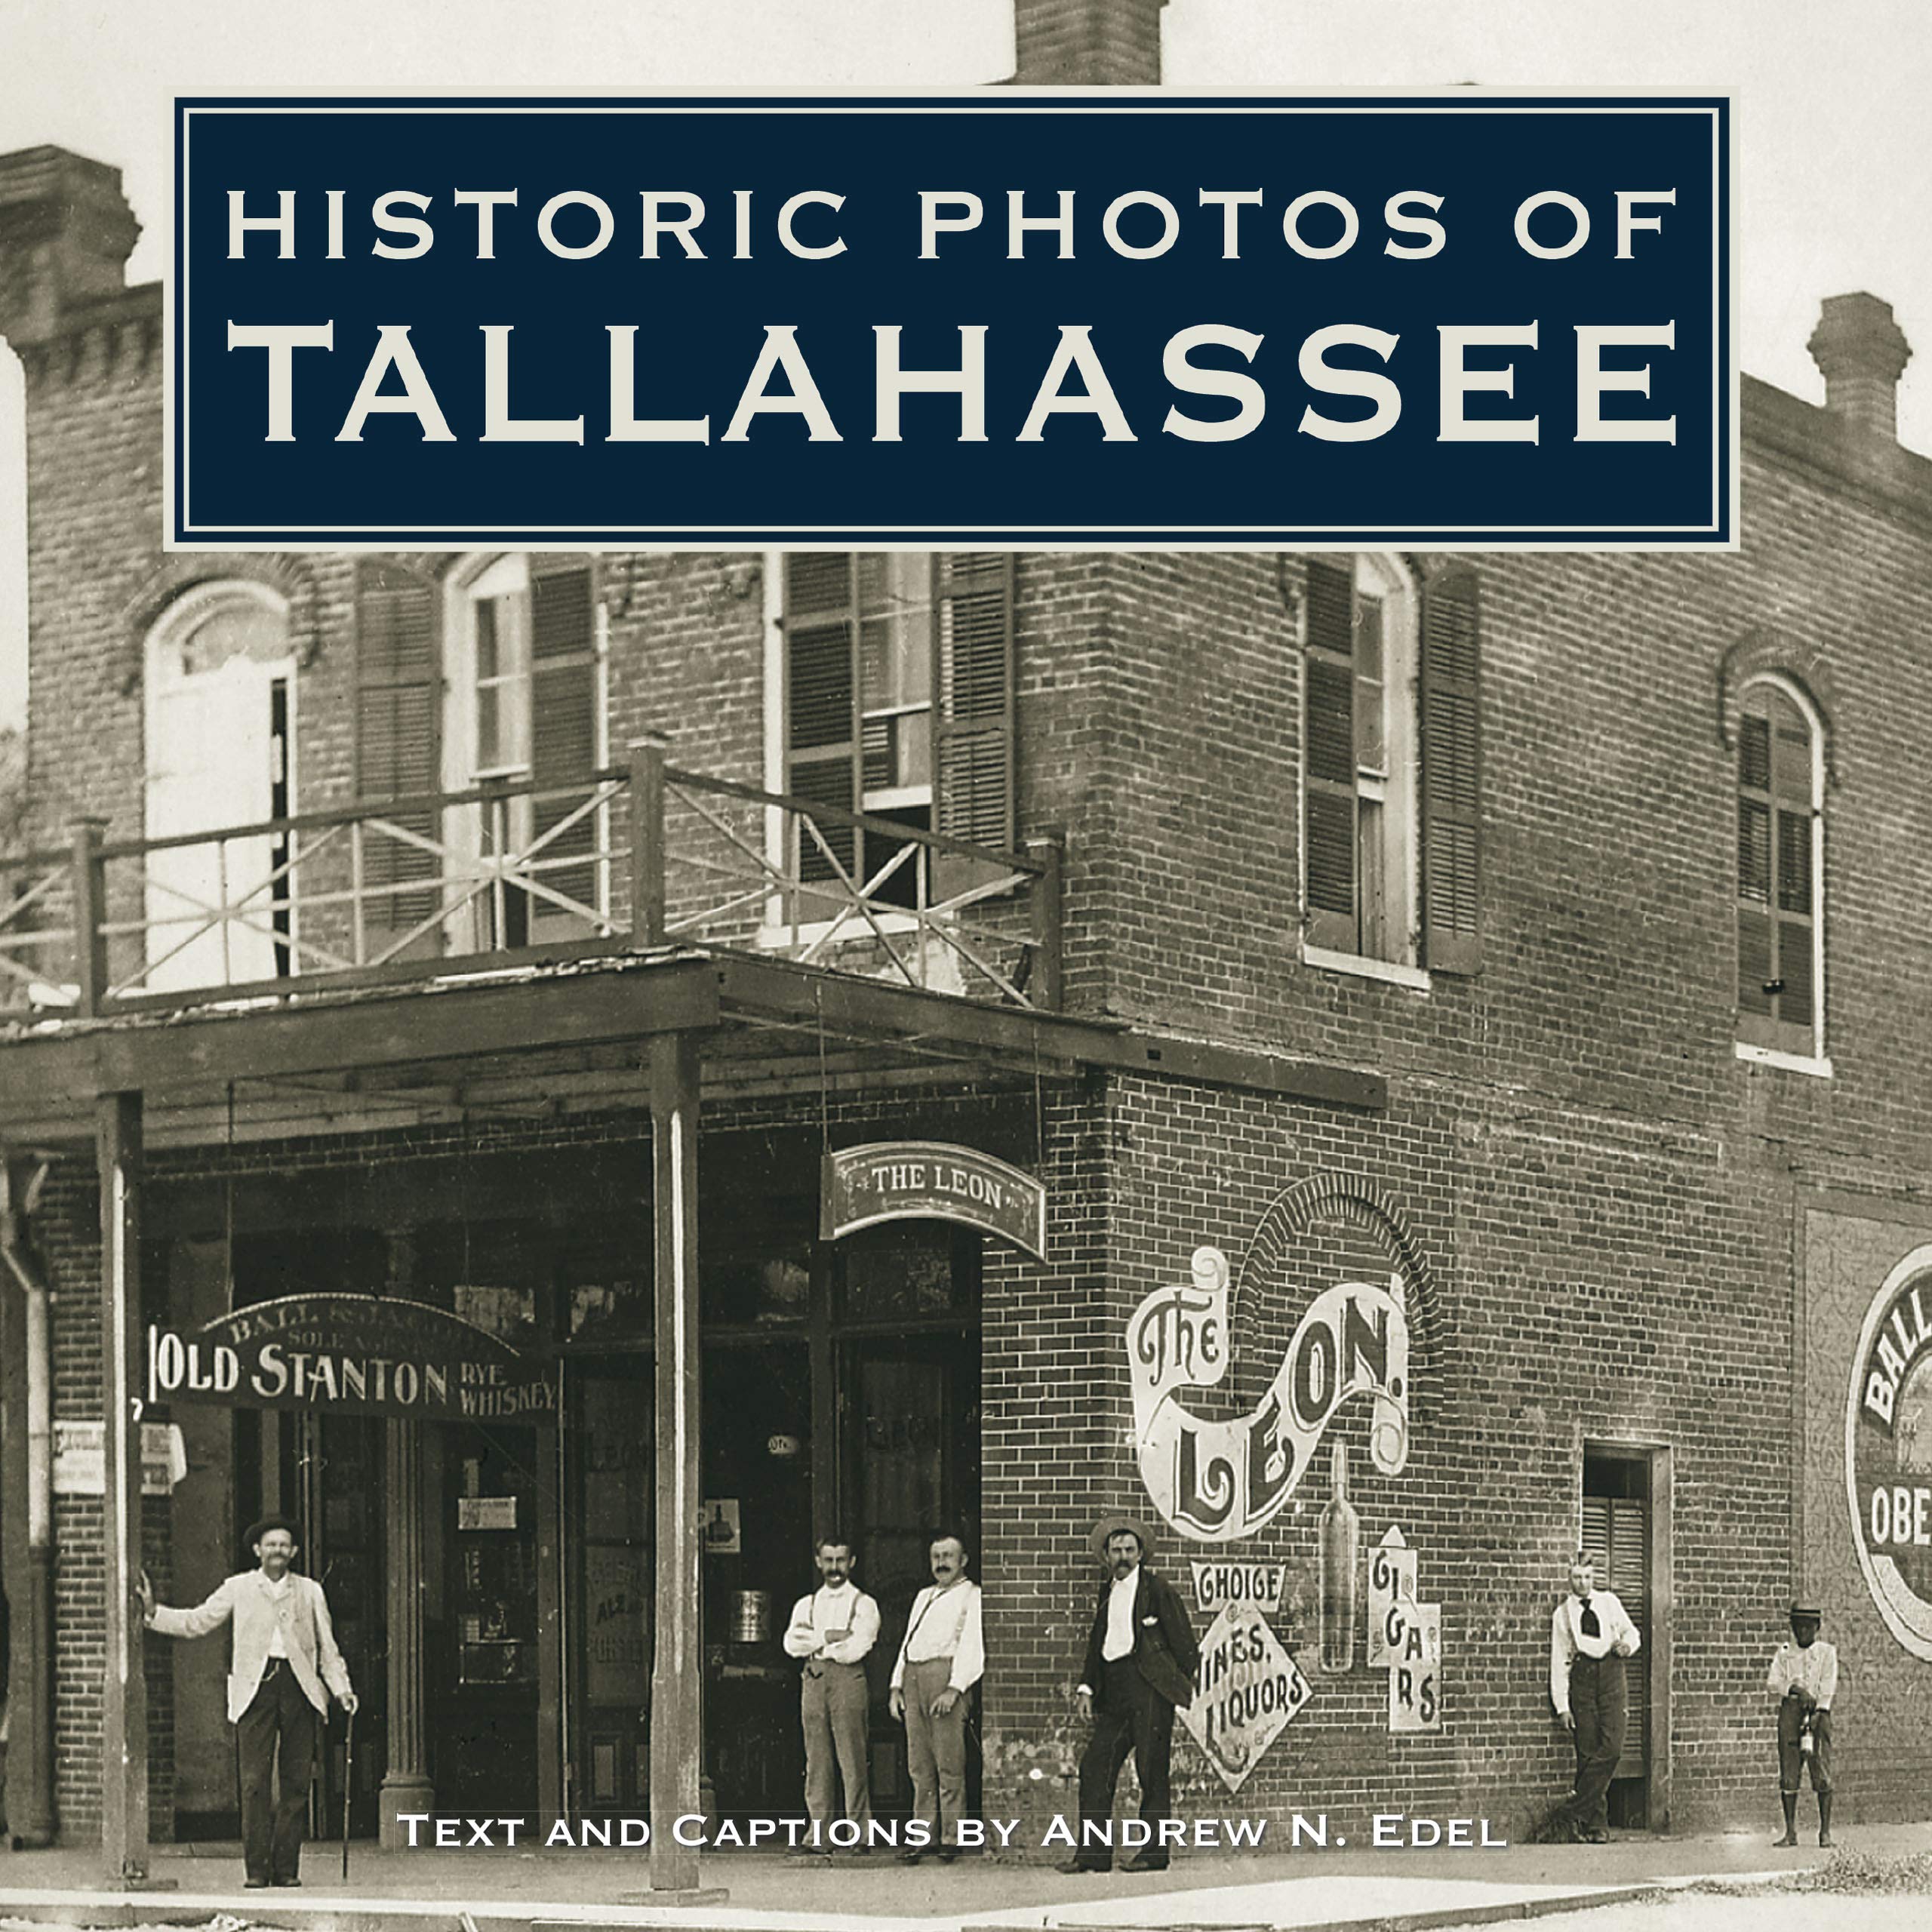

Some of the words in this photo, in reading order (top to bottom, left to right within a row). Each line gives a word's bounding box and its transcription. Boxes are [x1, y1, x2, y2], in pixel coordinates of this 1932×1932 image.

[871, 1164, 926, 1193] THE
[934, 1168, 1002, 1210] LEON
[228, 1303, 320, 1345] BALL
[157, 1333, 239, 1392] OLD
[251, 1343, 448, 1406] STANTON
[1205, 1670, 1303, 1774] LIQUORS
